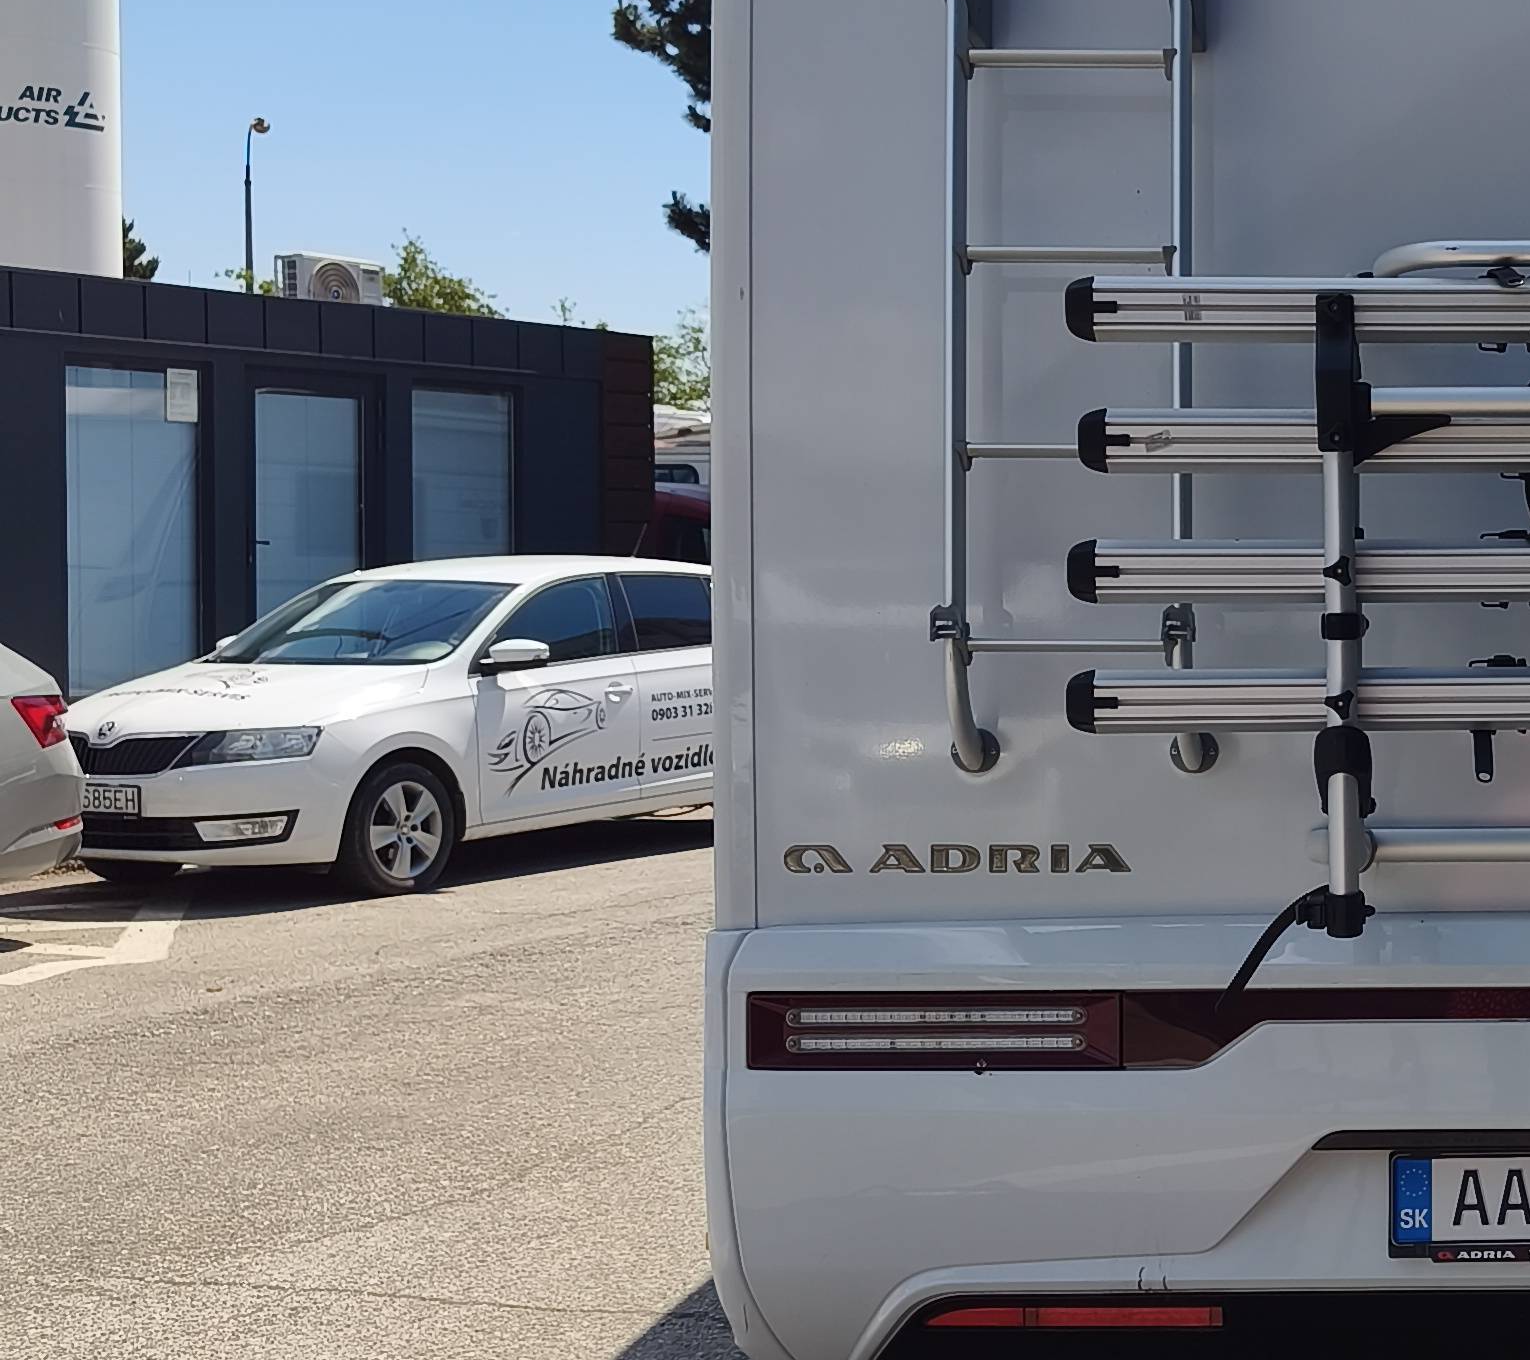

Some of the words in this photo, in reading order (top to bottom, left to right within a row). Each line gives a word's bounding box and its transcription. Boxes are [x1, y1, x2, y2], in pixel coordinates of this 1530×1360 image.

[18, 85, 62, 103] AIR
[651, 706, 679, 721] 0903
[681, 705, 693, 718] 31
[541, 753, 645, 790] Náhradné
[869, 843, 1132, 874] ADRIA
[1400, 1208, 1428, 1229] SK
[1456, 1250, 1516, 1259] ADRIA
